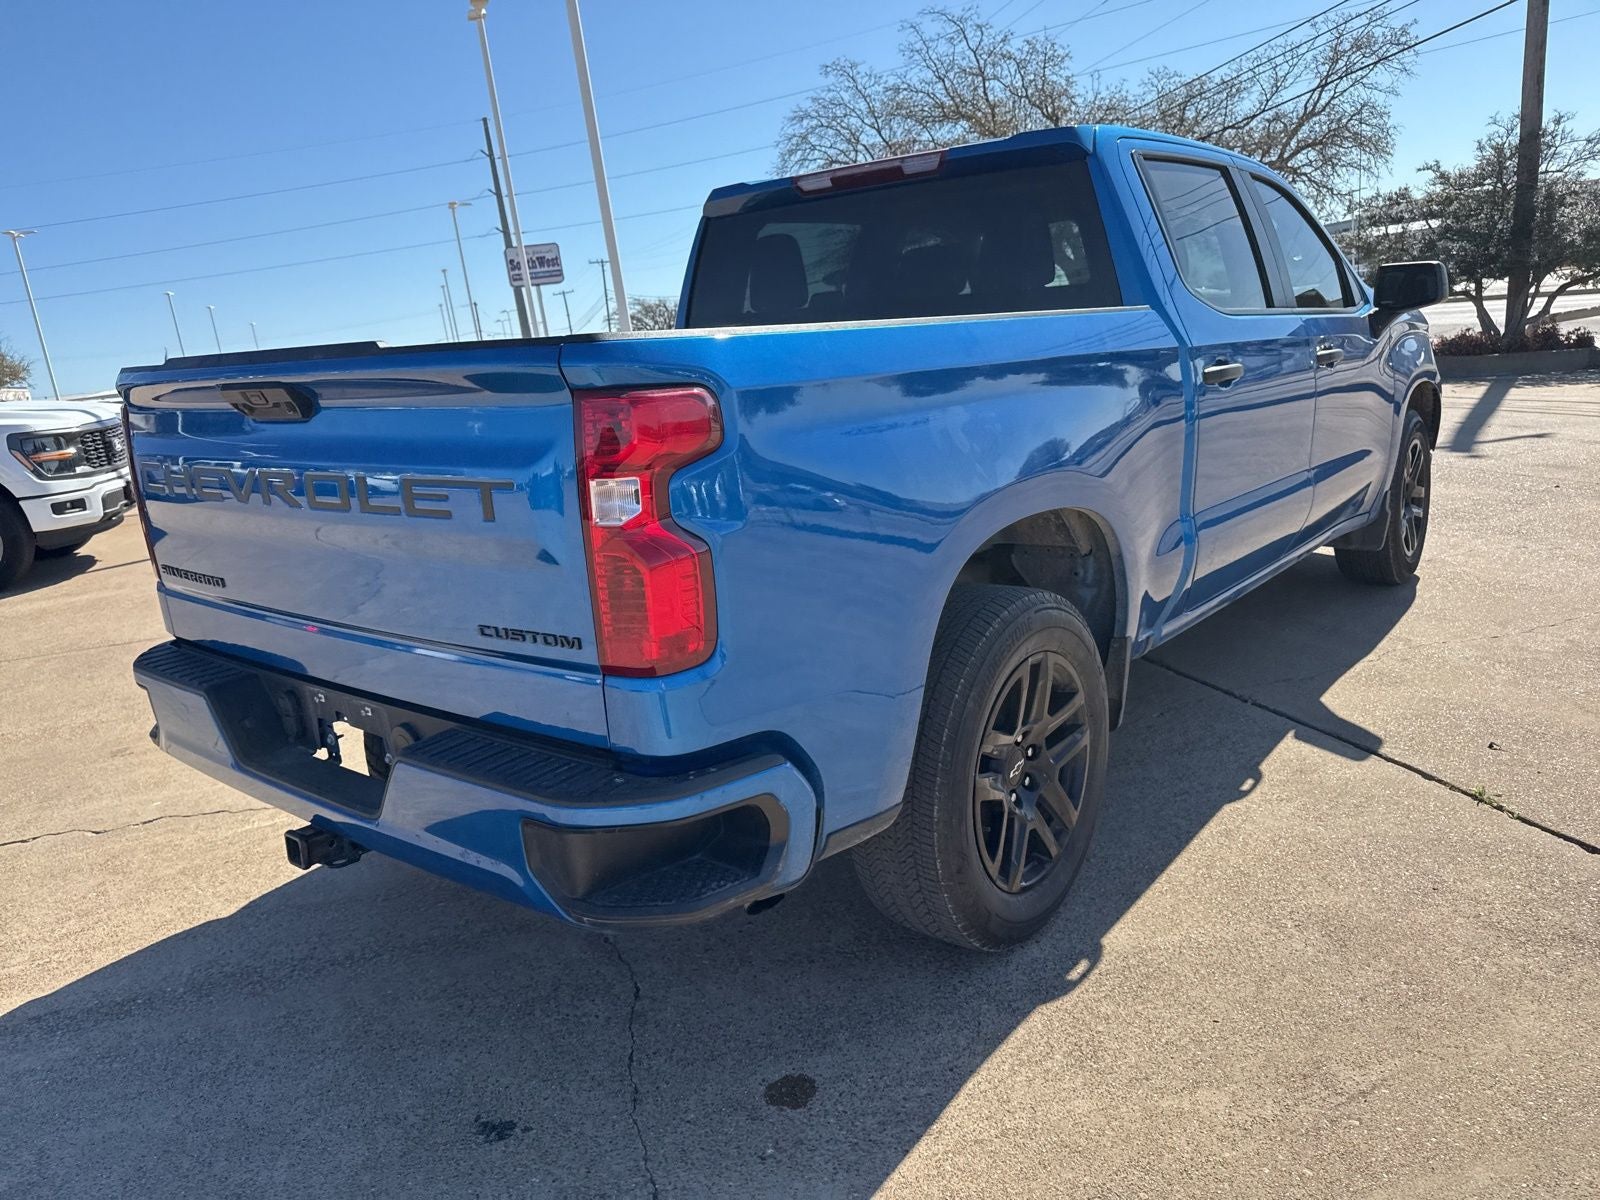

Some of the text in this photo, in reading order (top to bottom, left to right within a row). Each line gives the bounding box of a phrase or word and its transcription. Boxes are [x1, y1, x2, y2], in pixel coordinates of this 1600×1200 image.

[508, 255, 560, 272] SothWest
[140, 460, 516, 523] CHEVROLET
[160, 564, 227, 588] SILVERADO
[477, 624, 583, 650] CUSTOM
